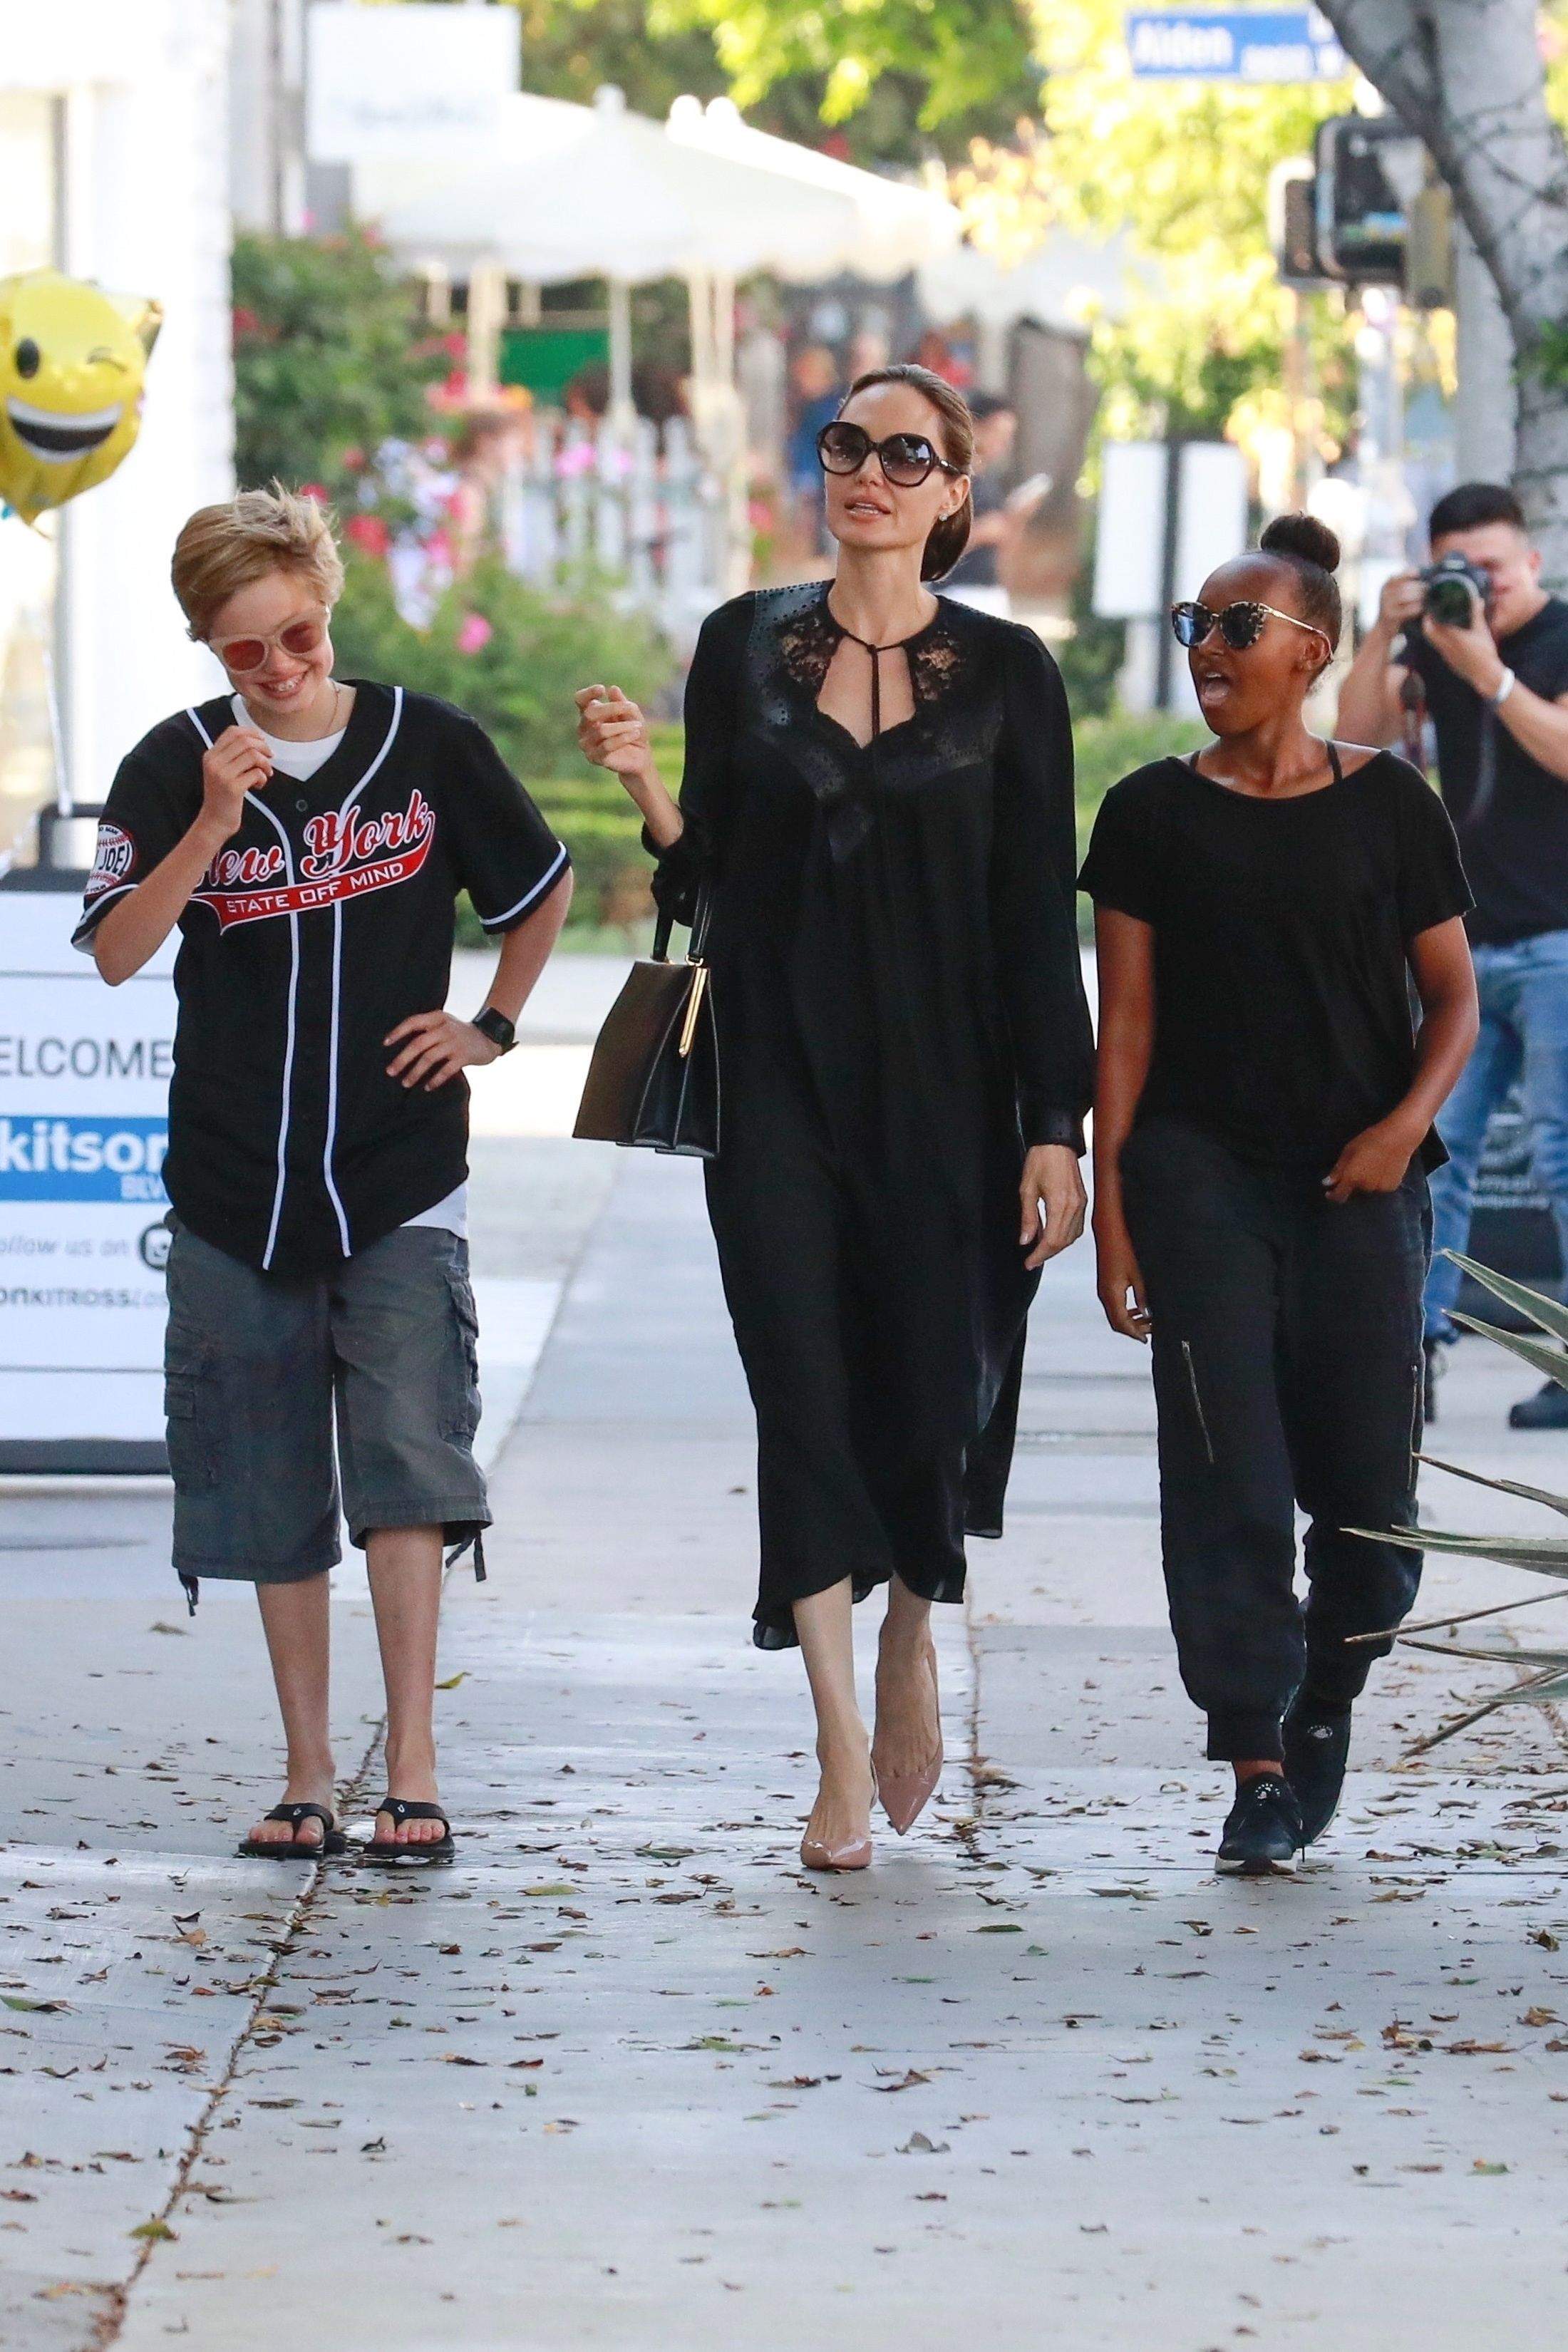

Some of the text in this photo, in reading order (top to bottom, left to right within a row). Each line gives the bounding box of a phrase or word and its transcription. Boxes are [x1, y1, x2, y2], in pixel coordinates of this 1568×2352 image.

[226, 862, 404, 913] STATE OFF MIND
